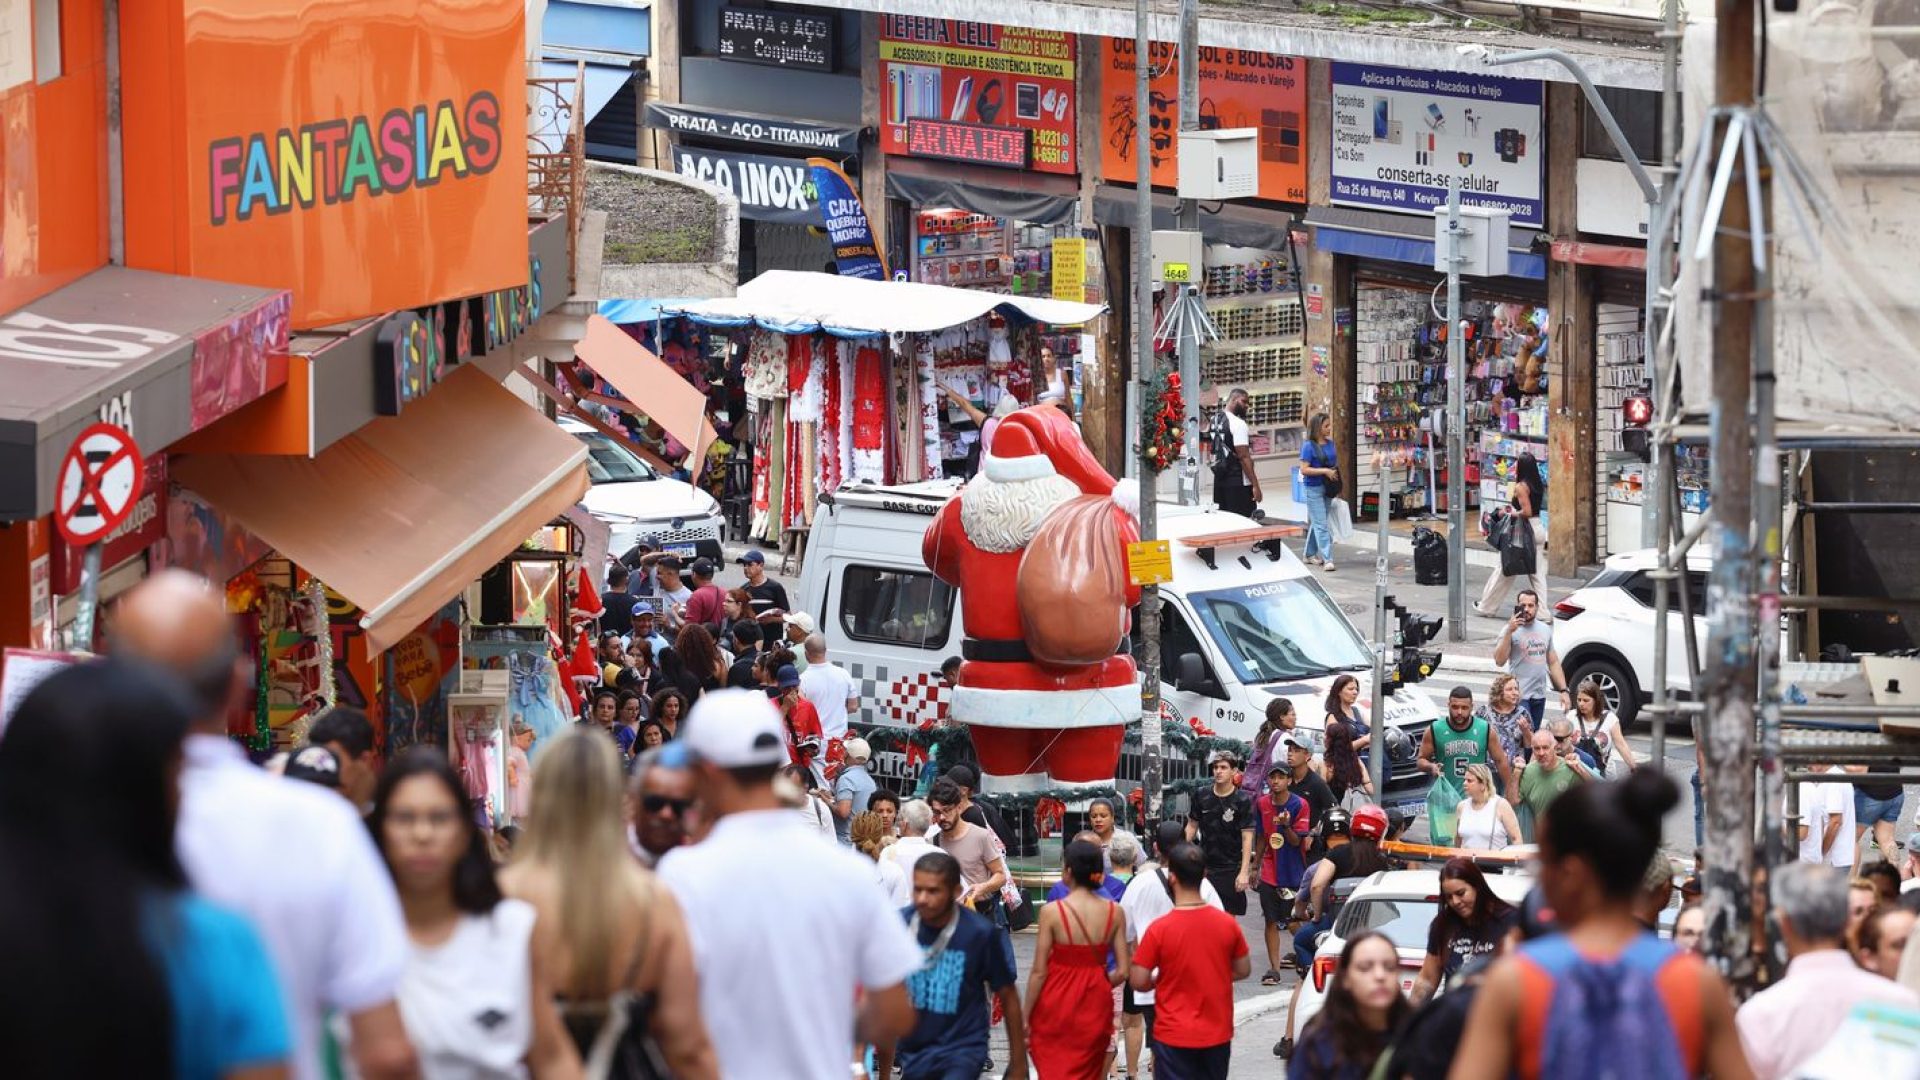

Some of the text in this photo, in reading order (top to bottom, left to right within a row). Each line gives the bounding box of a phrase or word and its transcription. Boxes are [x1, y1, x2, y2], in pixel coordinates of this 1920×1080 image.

[724, 11, 775, 33] PRATA
[794, 19, 827, 42] AÇO
[955, 20, 997, 48] CELL
[754, 38, 825, 64] Conjuntos
[944, 52, 977, 67] CELULAR
[978, 56, 984, 68] E
[1238, 49, 1294, 71] BOLSAS
[1225, 69, 1258, 84] Atacado
[1268, 73, 1295, 90] Varejo
[1360, 71, 1394, 86] Aplica-se
[1477, 84, 1502, 98] Varejo
[669, 114, 718, 133] PRATA
[209, 91, 502, 226] FANTASIAS
[738, 161, 810, 211] INOX
[1377, 166, 1450, 188] conserta-se
[1287, 187, 1304, 199] 644
[1336, 181, 1350, 194] Rua
[1351, 183, 1360, 196] 25
[1360, 185, 1369, 197] de
[1414, 191, 1440, 205] Kevin
[1164, 269, 1188, 279] 4648
[882, 500, 914, 512] BASE
[1227, 710, 1245, 723] 190
[1453, 757, 1470, 778] 5
